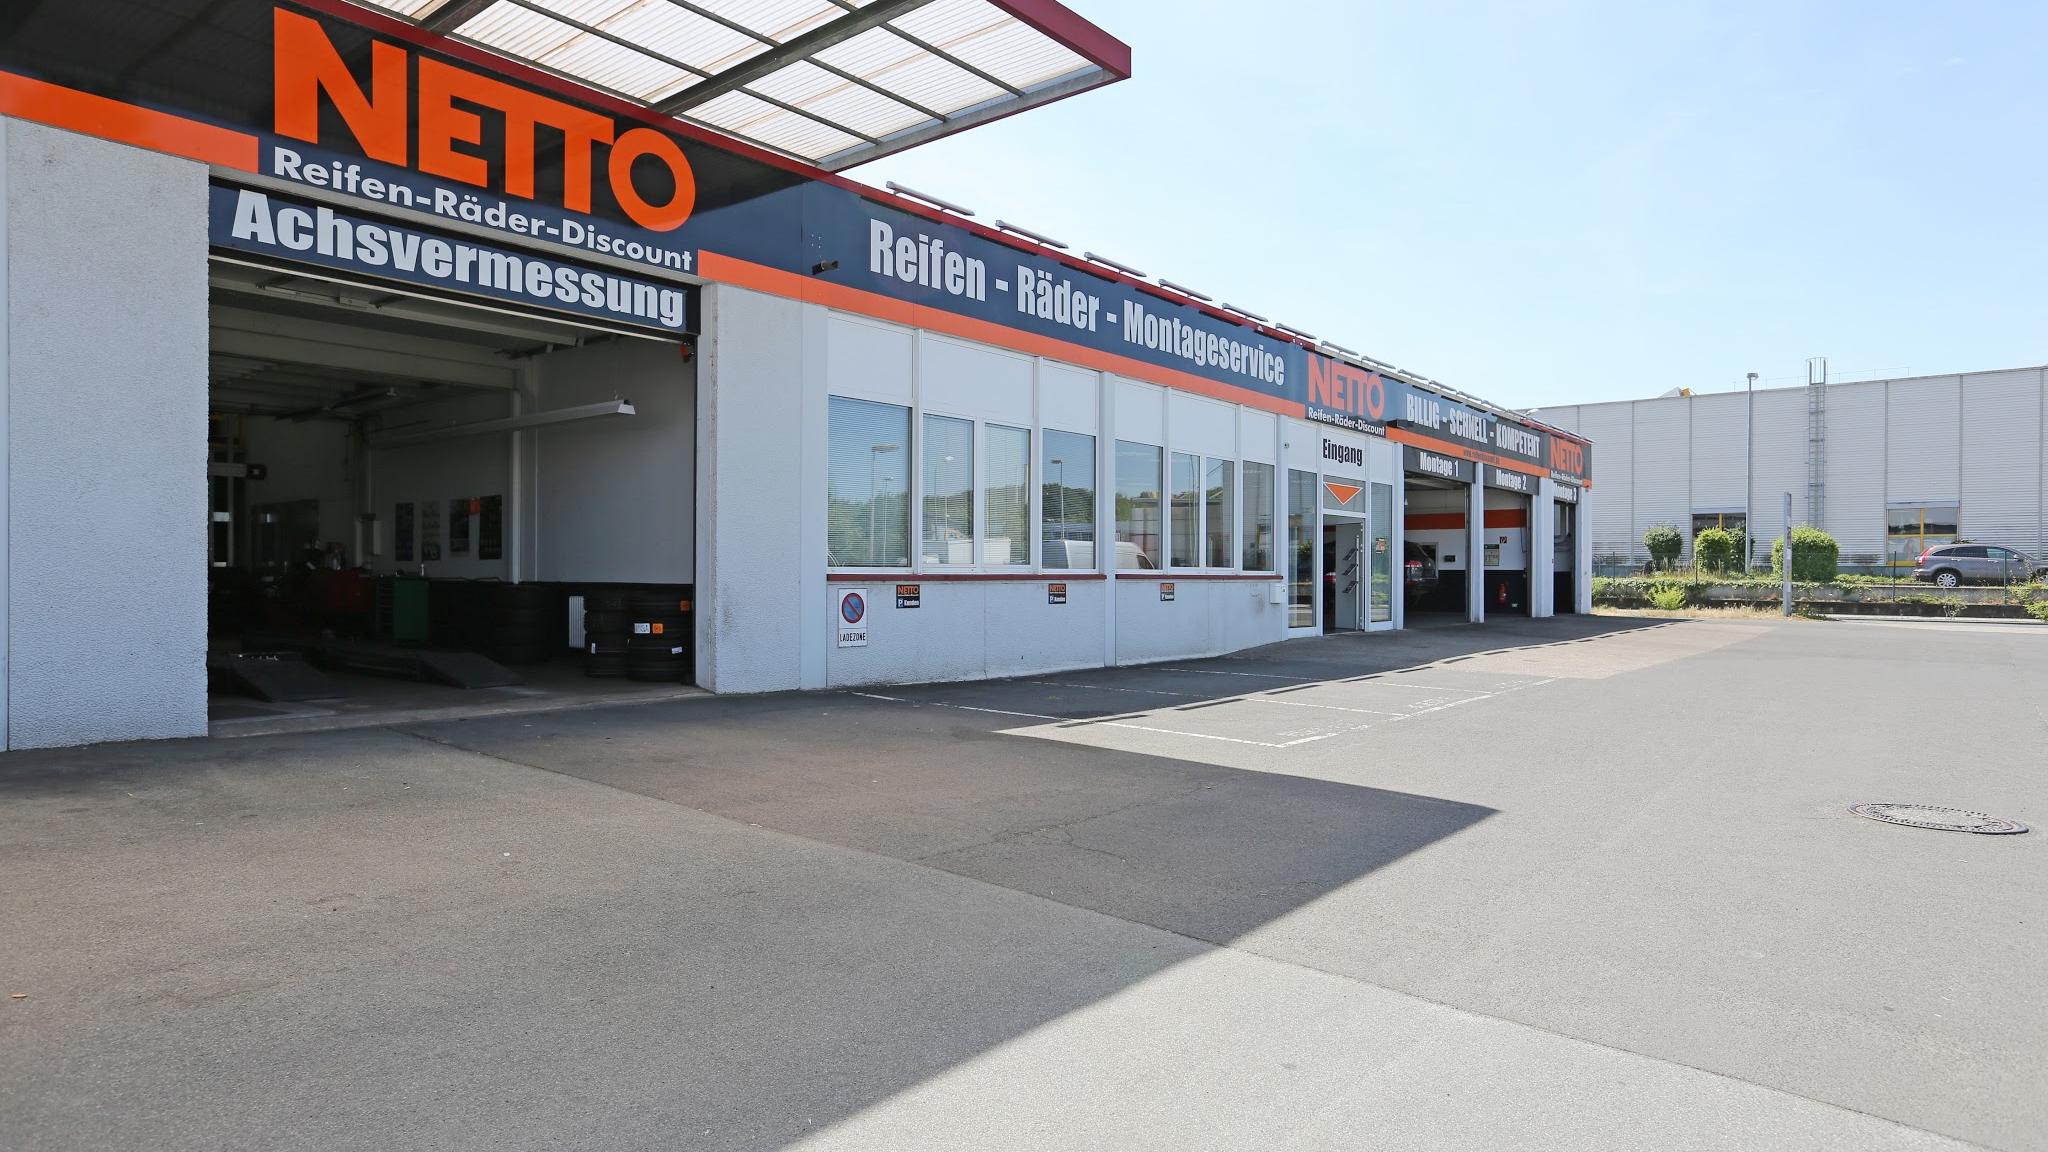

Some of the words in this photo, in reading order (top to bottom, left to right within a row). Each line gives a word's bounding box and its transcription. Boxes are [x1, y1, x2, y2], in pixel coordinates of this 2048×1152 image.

[274, 6, 696, 232] NETTO
[274, 147, 692, 272] Reifen-Räder-Discount
[231, 189, 685, 330] Achsvermessung
[870, 218, 986, 302] Reifen
[1017, 264, 1100, 332] Räder
[1123, 299, 1285, 386] Montageservice
[1308, 352, 1385, 421] NETTO
[1308, 406, 1385, 435] Reifen-Räder-Discount
[1406, 393, 1440, 430] BILLIG
[1449, 407, 1488, 444] SCHNELL
[1496, 423, 1540, 458] KOMPETENT
[1322, 438, 1363, 467] Eingang
[1420, 451, 1453, 477] Montage
[1454, 460, 1459, 477] 1
[1551, 435, 1584, 475] NETTO
[1496, 468, 1521, 490] Montage
[1522, 474, 1527, 491] 2
[898, 585, 919, 595] NETTO
[839, 632, 866, 642] LADEZONE
